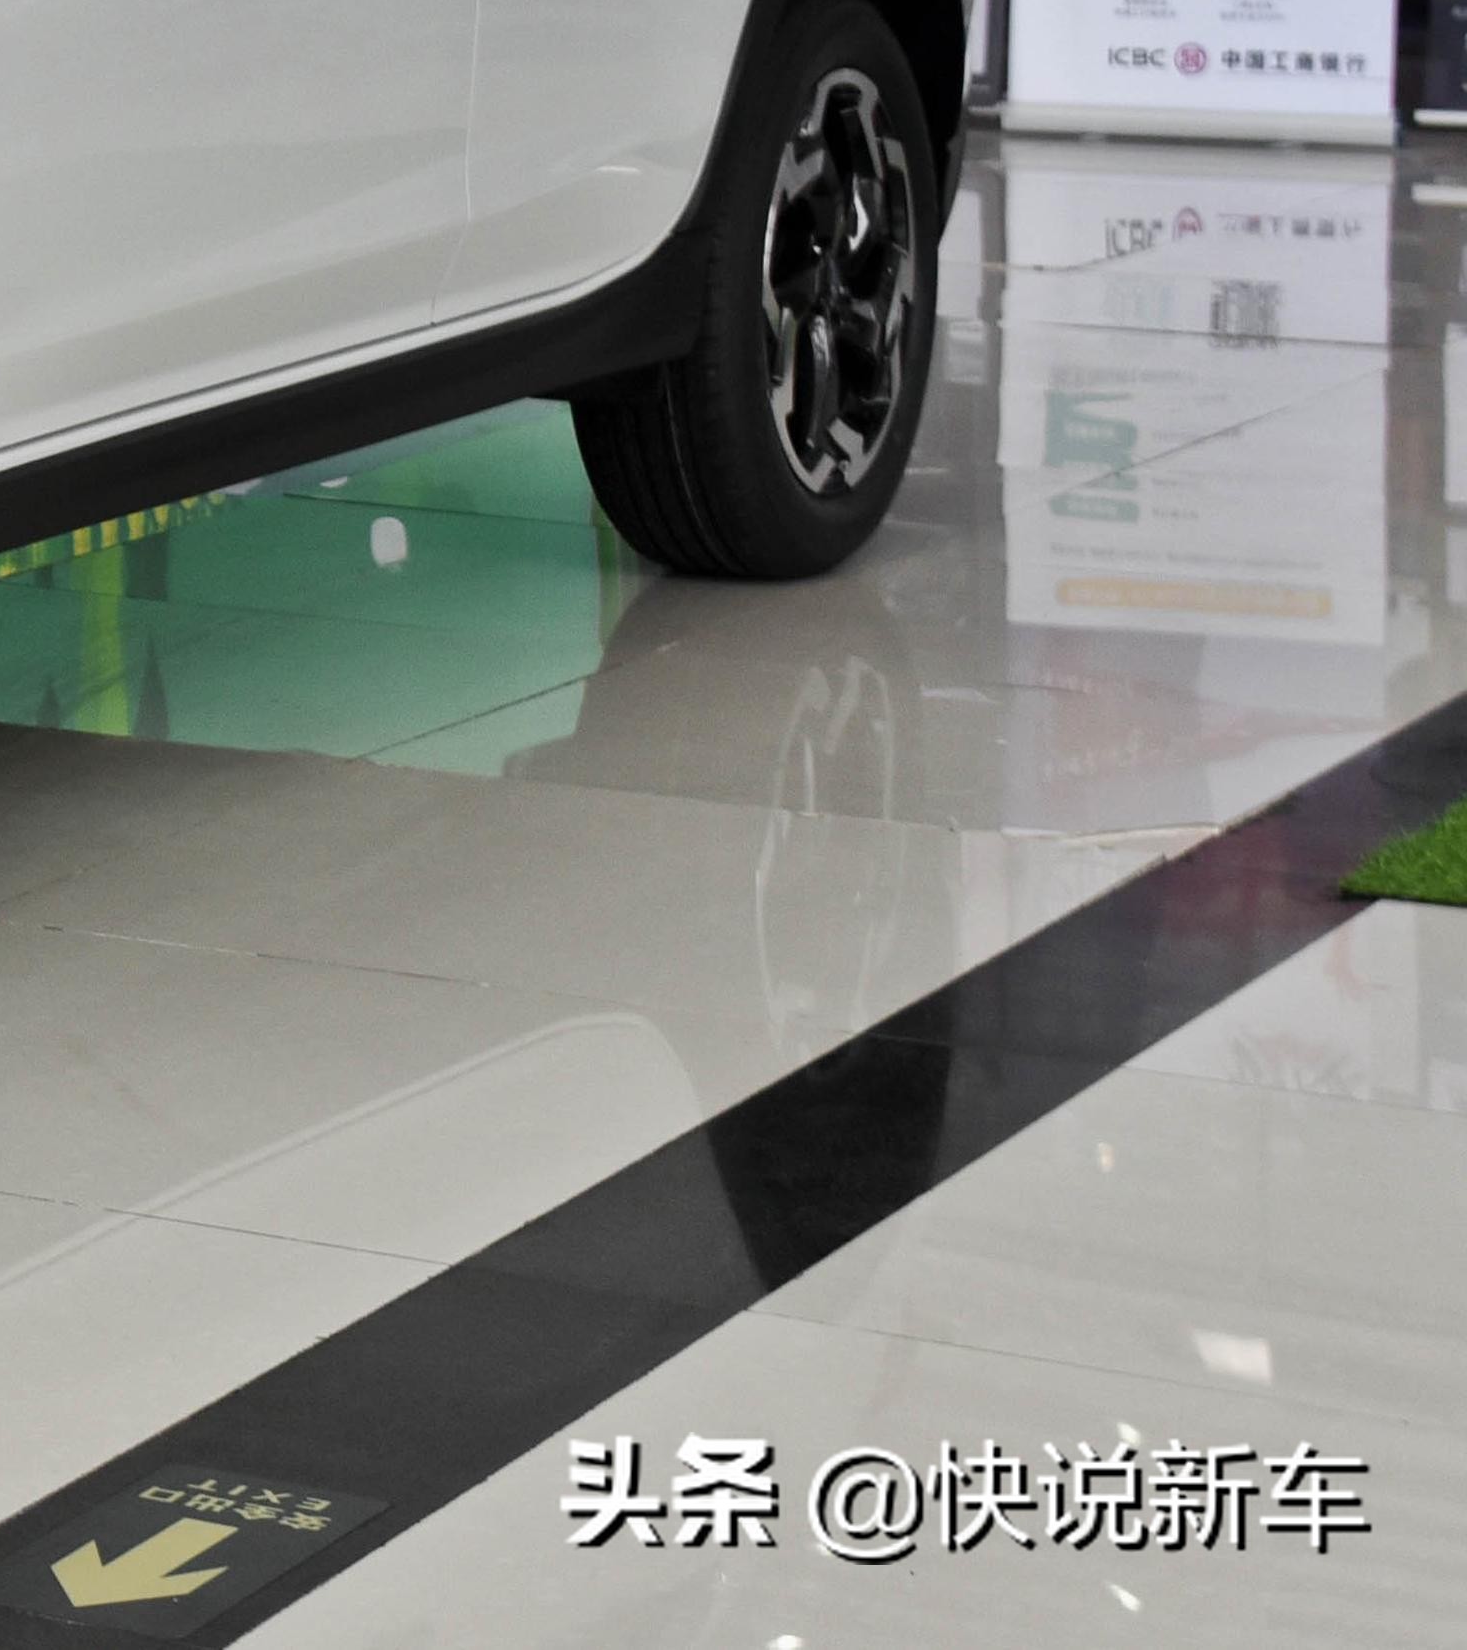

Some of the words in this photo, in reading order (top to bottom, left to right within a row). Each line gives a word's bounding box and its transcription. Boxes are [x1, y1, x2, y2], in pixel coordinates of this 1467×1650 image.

[1107, 48, 1165, 67] ICBC
[1220, 48, 1366, 73] 中国工商银行
[186, 1478, 333, 1512] EXIT
